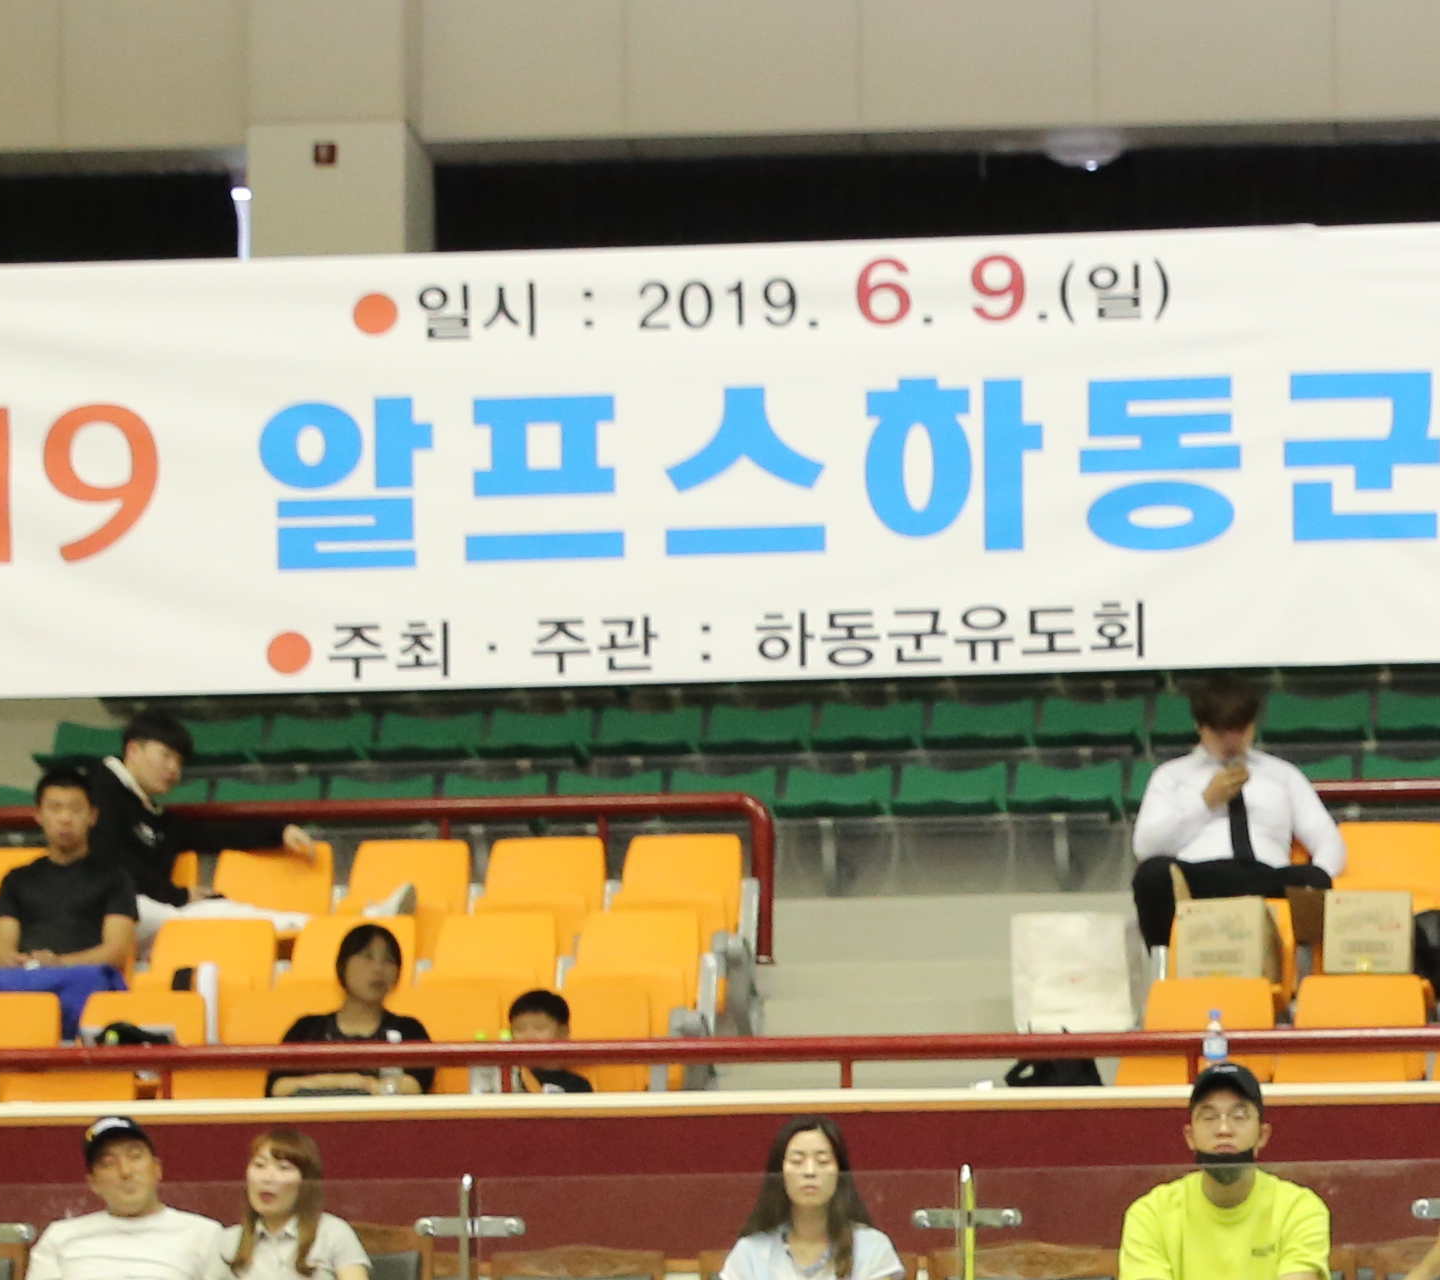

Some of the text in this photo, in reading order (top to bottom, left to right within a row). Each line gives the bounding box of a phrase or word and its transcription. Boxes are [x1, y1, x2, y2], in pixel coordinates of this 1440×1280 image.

[418, 282, 537, 341] 일시
[640, 279, 819, 330] 2019.
[856, 258, 934, 327] 6.
[330, 621, 450, 681] 주최
[533, 616, 659, 676] 주관
[757, 601, 1147, 669] 하동군유도회
